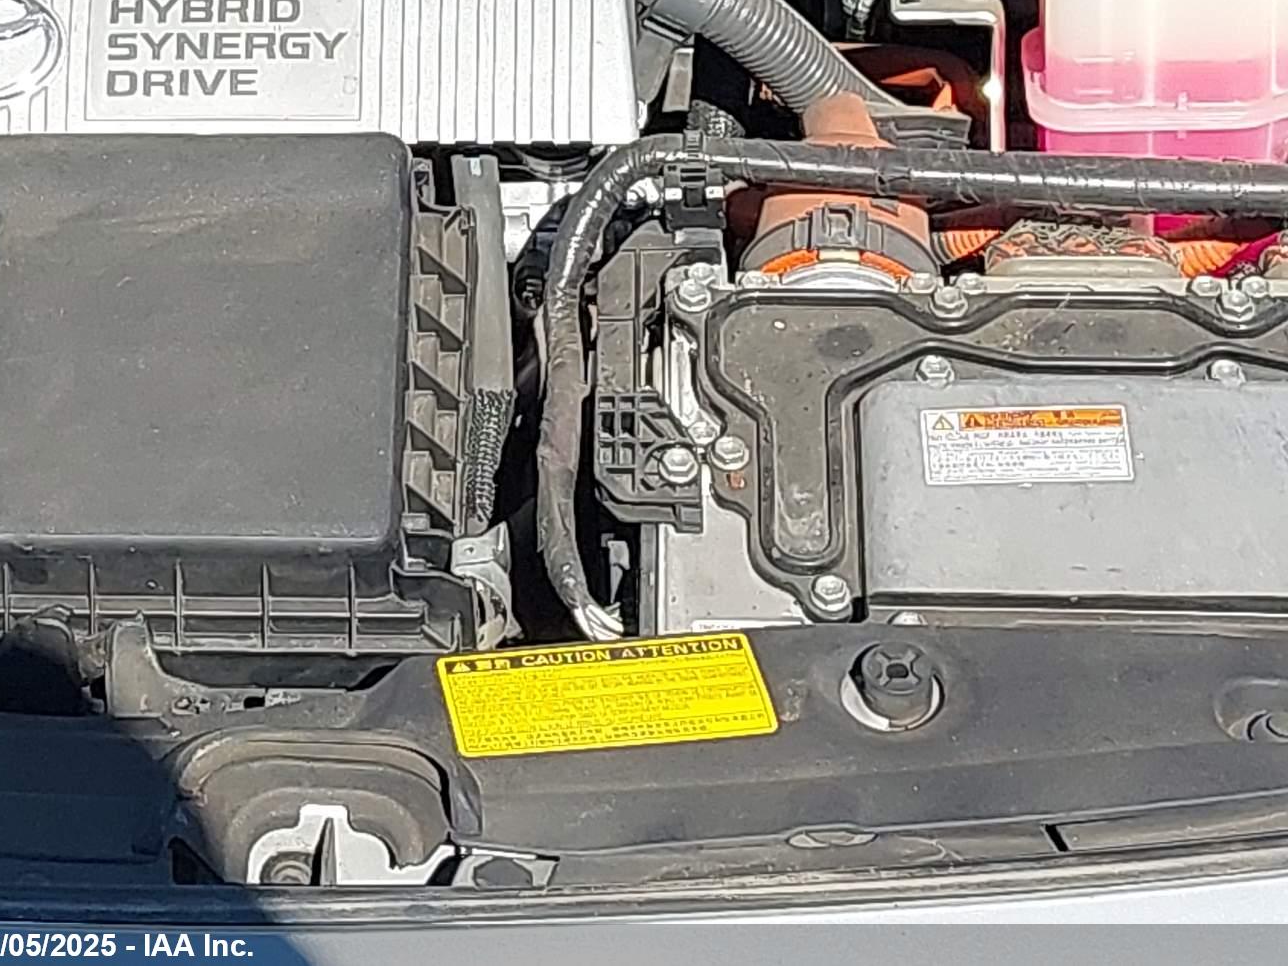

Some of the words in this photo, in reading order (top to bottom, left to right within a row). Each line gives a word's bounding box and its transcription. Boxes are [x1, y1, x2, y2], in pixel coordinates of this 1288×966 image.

[107, 31, 347, 61] SYNERGY
[107, 69, 259, 96] DRIVE
[521, 650, 611, 667] CAUTION
[621, 638, 738, 658] ATTENTION
